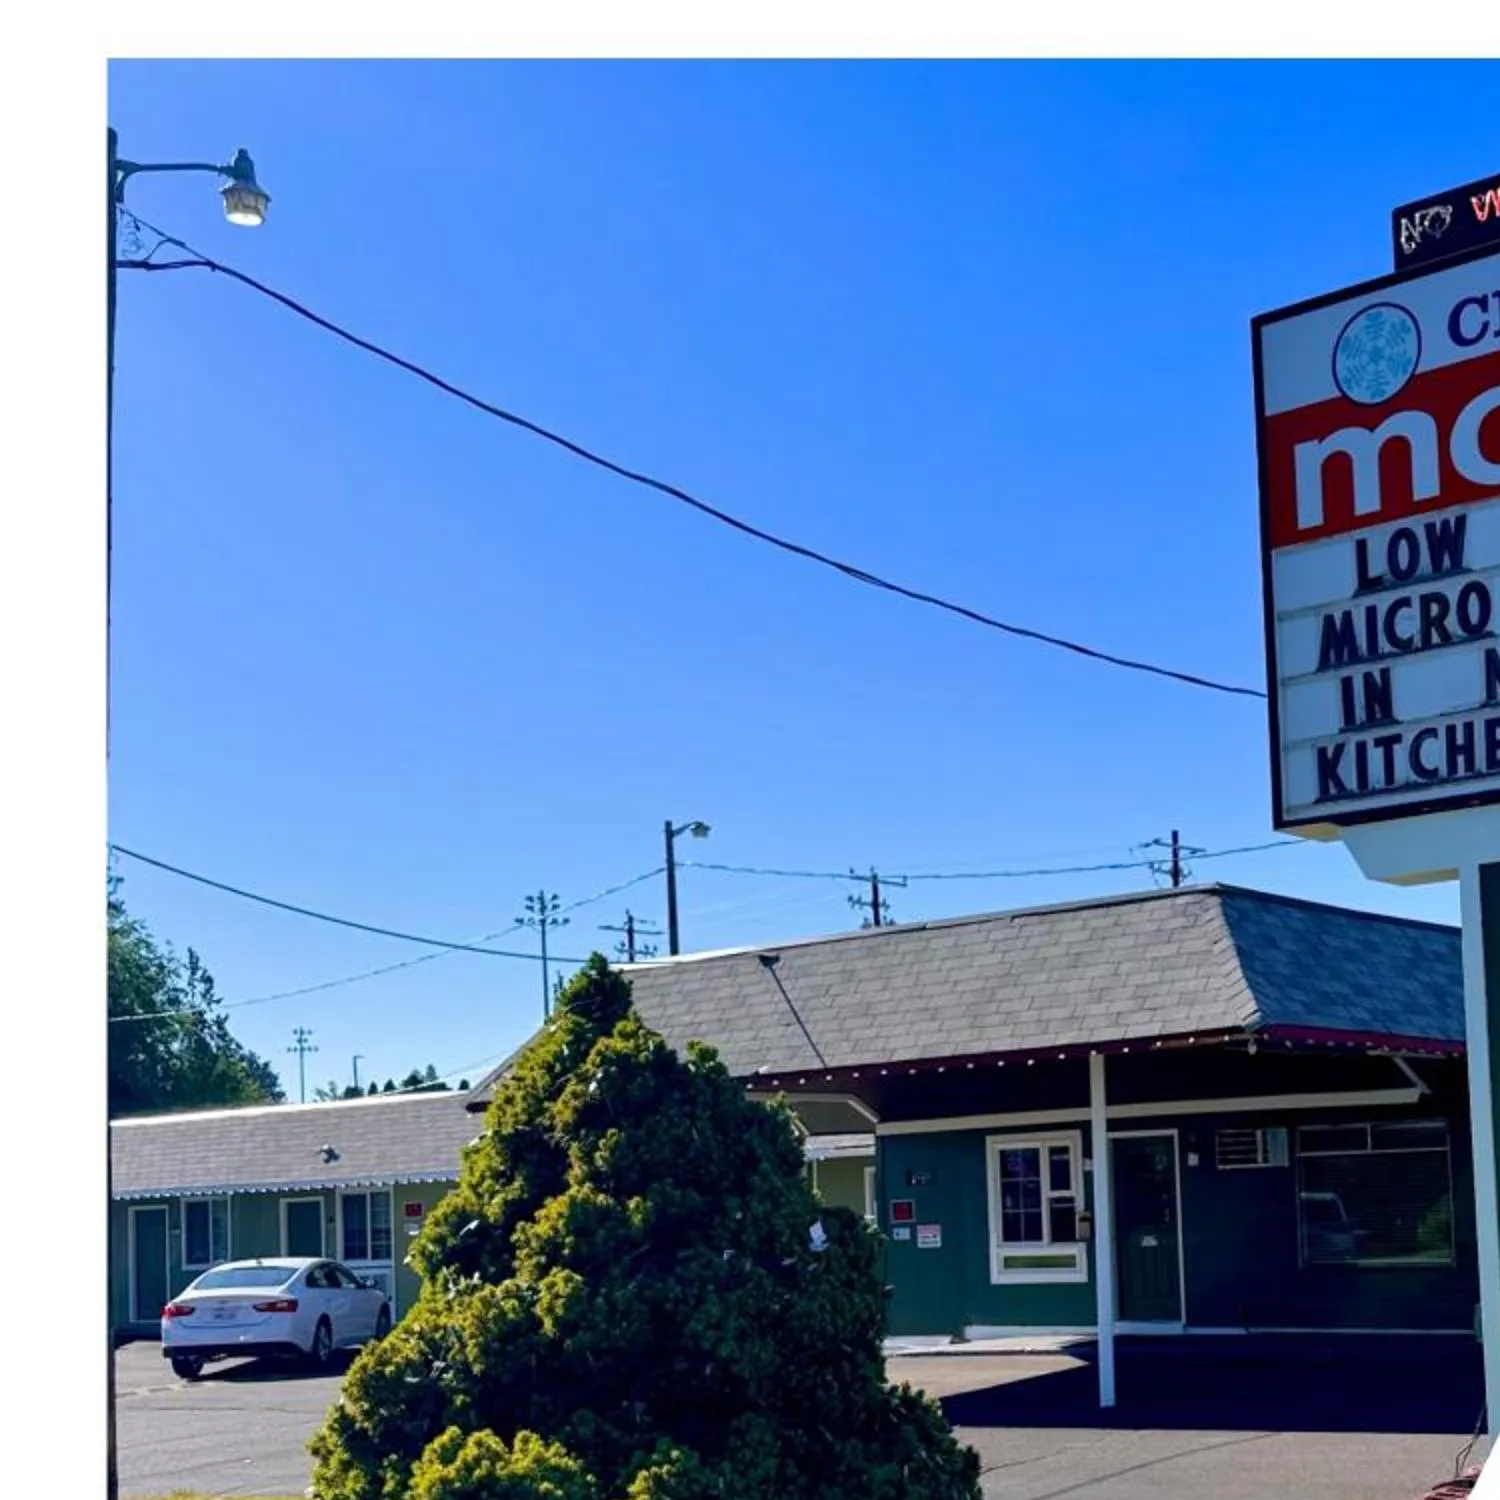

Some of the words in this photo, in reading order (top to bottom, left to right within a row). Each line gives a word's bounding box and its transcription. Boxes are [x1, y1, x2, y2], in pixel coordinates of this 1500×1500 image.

[1355, 514, 1467, 593] LOW
[1317, 587, 1492, 671] MICRO
[1340, 667, 1393, 731] IN
